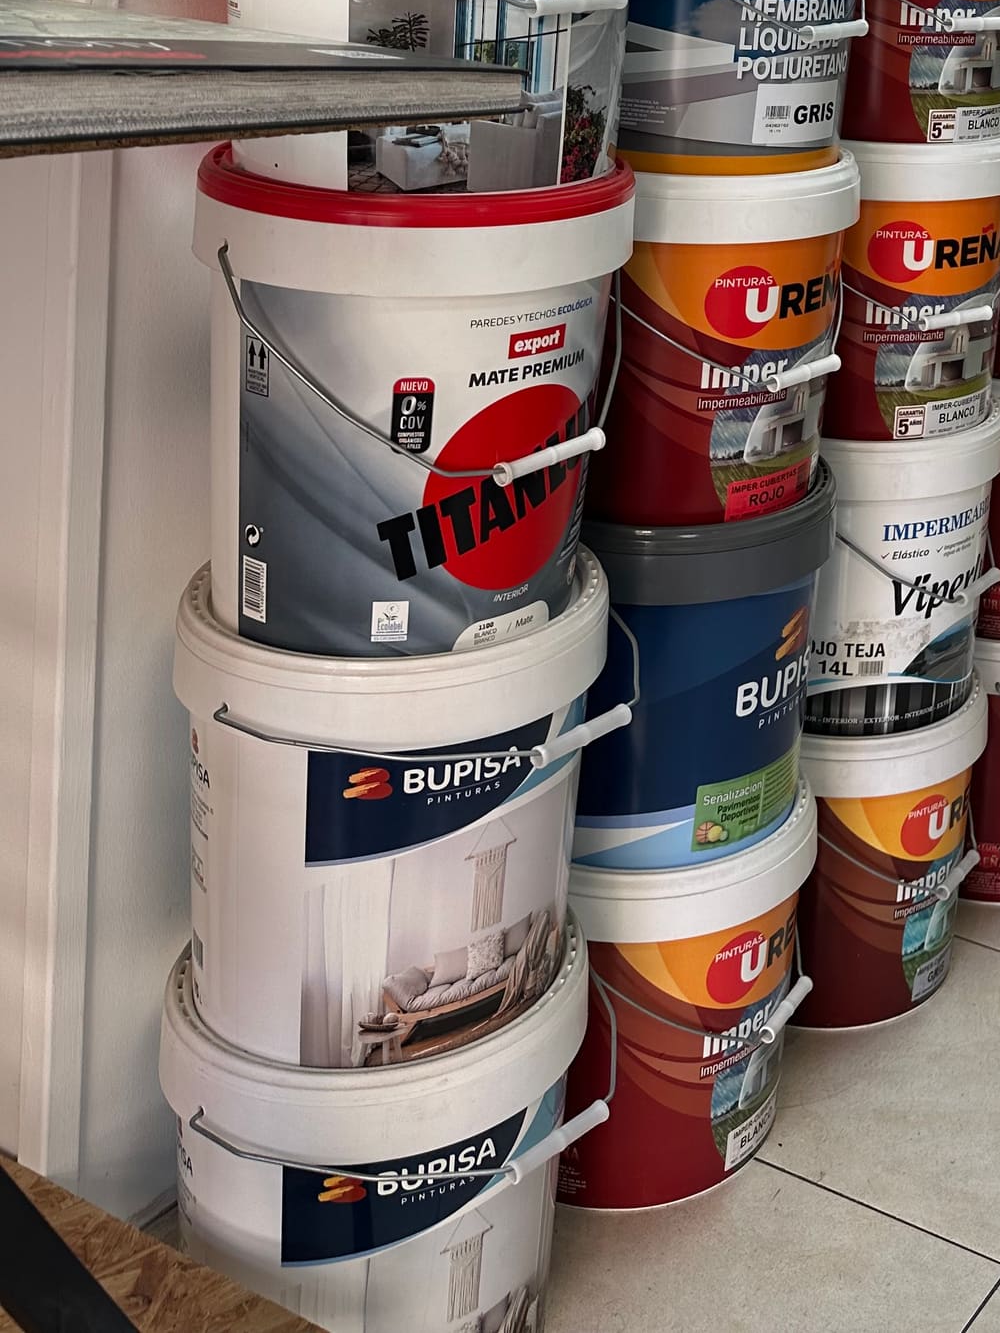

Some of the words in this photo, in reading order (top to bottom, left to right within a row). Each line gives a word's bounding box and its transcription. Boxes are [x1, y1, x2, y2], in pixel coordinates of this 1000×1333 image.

[900, 1, 977, 32] Imper
[897, 33, 976, 45] Impermeabilizante
[736, 48, 849, 81] POLIURETANO
[793, 101, 834, 125] GRIS
[967, 116, 1000, 130] BLANCO
[931, 122, 943, 139] 5
[876, 229, 928, 239] PINTURAS
[715, 275, 774, 288] PINTURAS
[470, 315, 516, 329] PAREDES
[524, 308, 557, 323] TECHOS
[556, 295, 594, 316] ECOLÓGICA
[865, 301, 945, 327] Imper
[513, 329, 561, 354] export
[863, 329, 944, 344] Impermeabilizante
[468, 367, 520, 388] MATE
[522, 348, 585, 380] PREMIUM
[700, 354, 790, 391] Imper
[400, 381, 428, 392] NUEVO
[697, 389, 787, 410] Impermeabilizante
[400, 416, 425, 429] COV
[939, 406, 975, 423] BLANCO
[898, 419, 909, 435] 5
[731, 483, 758, 494] IMPER
[759, 468, 798, 488] CUBIERTAS
[748, 486, 785, 506] ROJO
[892, 548, 930, 560] Elástico
[493, 583, 529, 602] INTERIOR
[377, 618, 404, 631] Ecolabel
[514, 614, 534, 628] Mate
[474, 628, 498, 639] BLANCO
[844, 642, 886, 658] TEJA
[818, 659, 853, 676] 14L
[402, 744, 523, 794] BUPISA
[426, 781, 502, 805] PINTURAS
[908, 798, 949, 820] PINTURAS
[896, 860, 952, 903] Imper
[714, 932, 764, 964] PINTURAS
[702, 999, 773, 1059] Imper
[376, 1137, 497, 1197] BUPISA
[401, 1173, 477, 1207] PINTURAS
